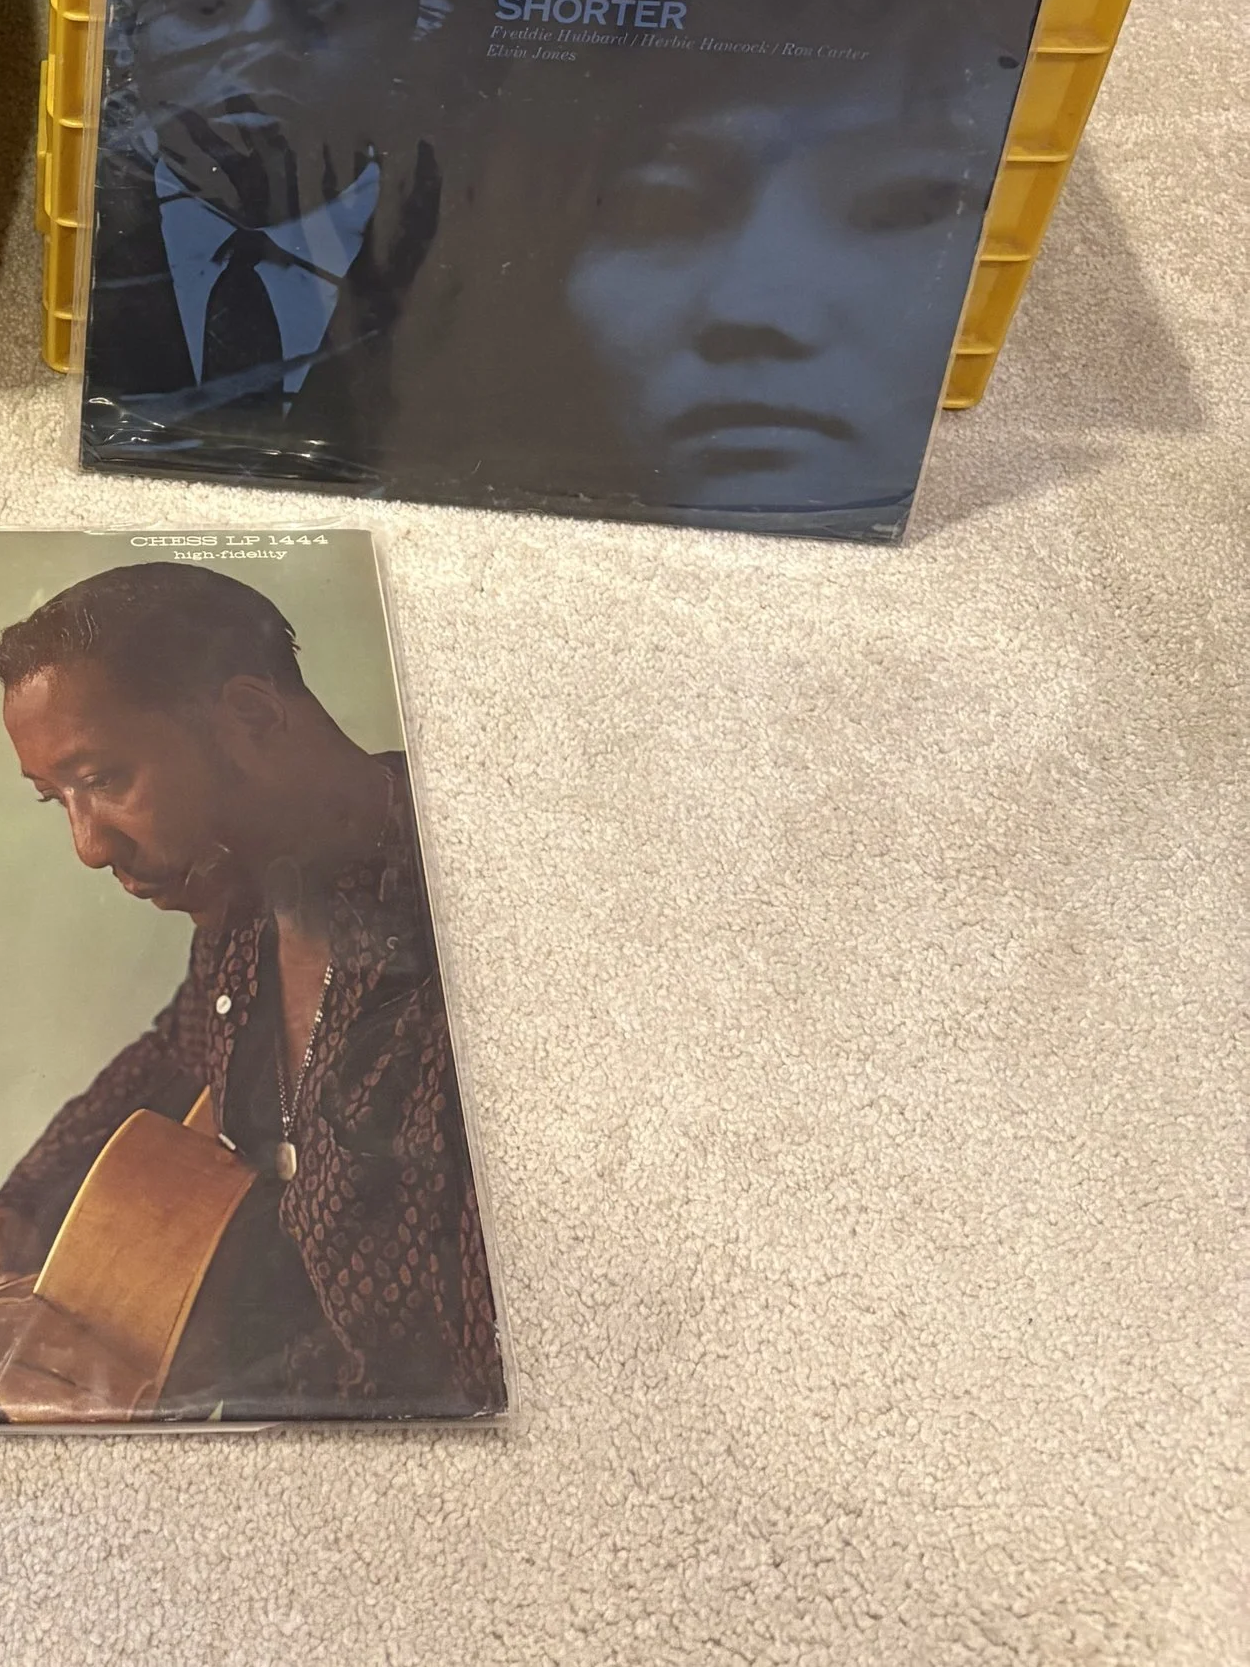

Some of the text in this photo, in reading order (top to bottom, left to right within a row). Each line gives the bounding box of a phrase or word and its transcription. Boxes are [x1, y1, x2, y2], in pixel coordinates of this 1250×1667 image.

[490, 25, 870, 62] Freddie Hubbard Herbie Hancock Ron Carter
[486, 44, 578, 62] Elvin Jones
[130, 533, 329, 547] CHESS LP 1444
[173, 548, 288, 561] high-fidelity
